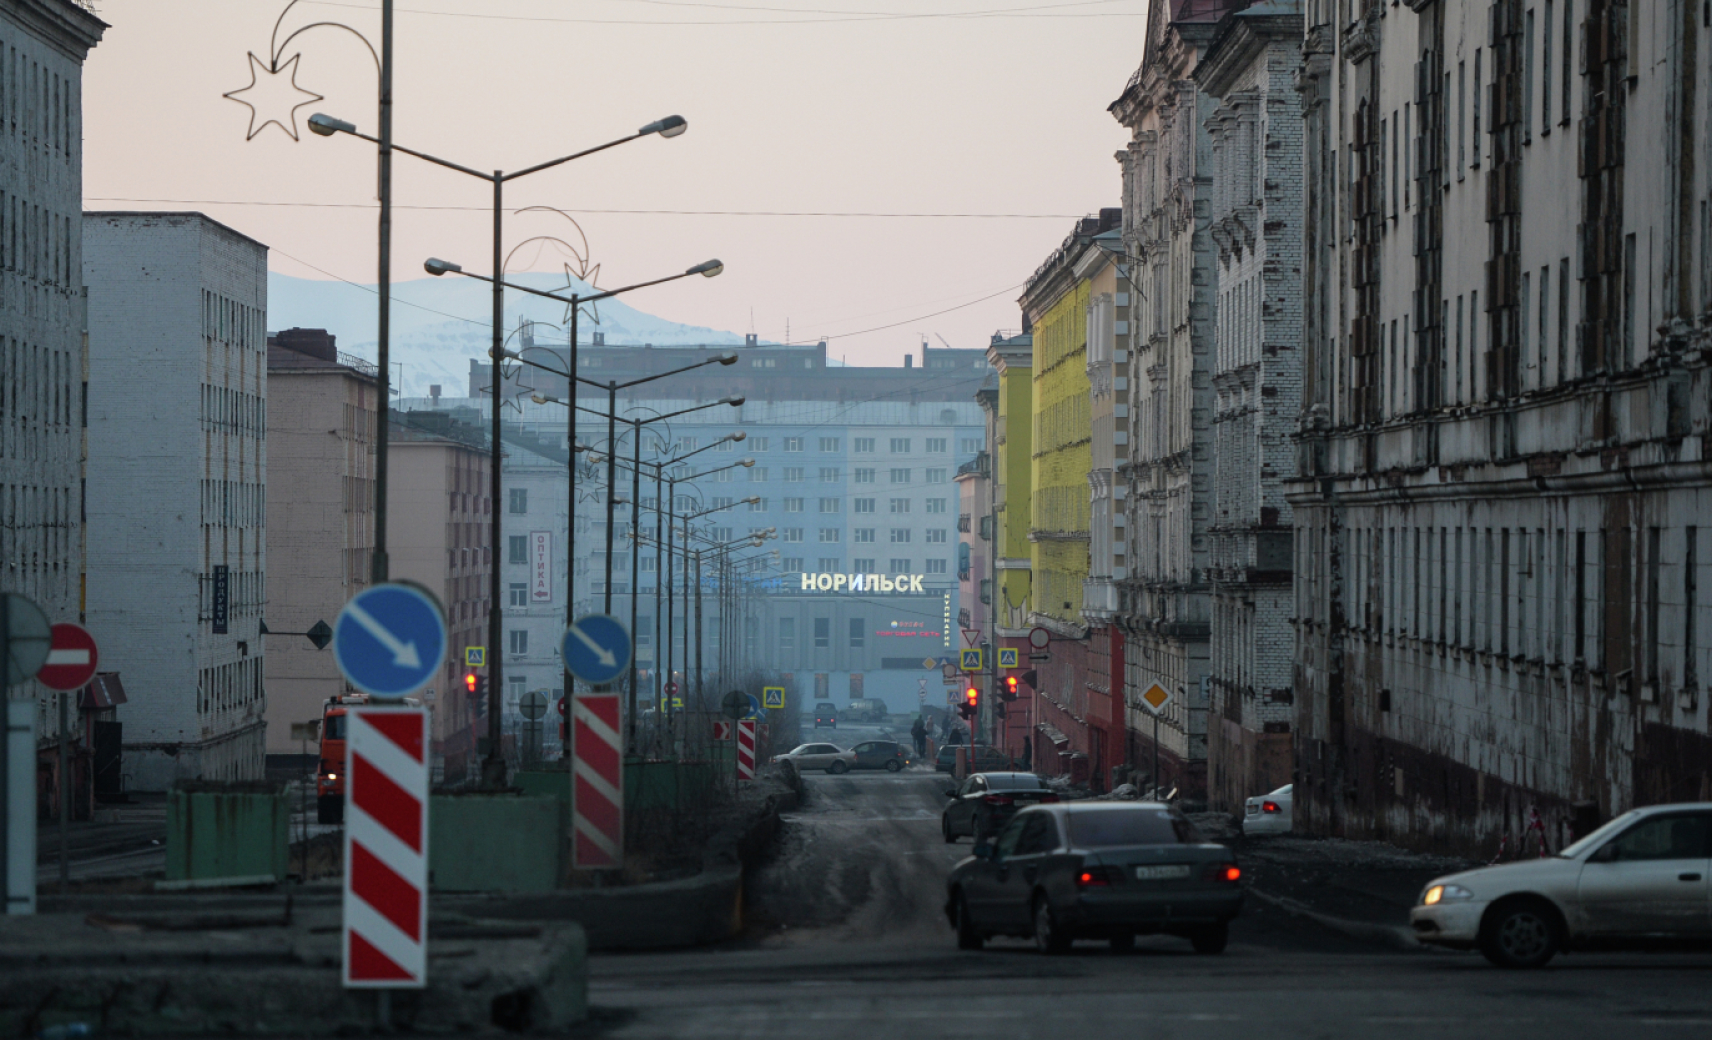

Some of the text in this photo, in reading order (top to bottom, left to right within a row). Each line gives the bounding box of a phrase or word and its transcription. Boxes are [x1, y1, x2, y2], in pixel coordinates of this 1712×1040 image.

[537, 535, 545, 588] ОПТИКА
[216, 567, 226, 626] ПРОДУКТЫ
[801, 572, 924, 592] НОРИЛЬСК
[875, 630, 917, 638] ТОРГОВАЯ
